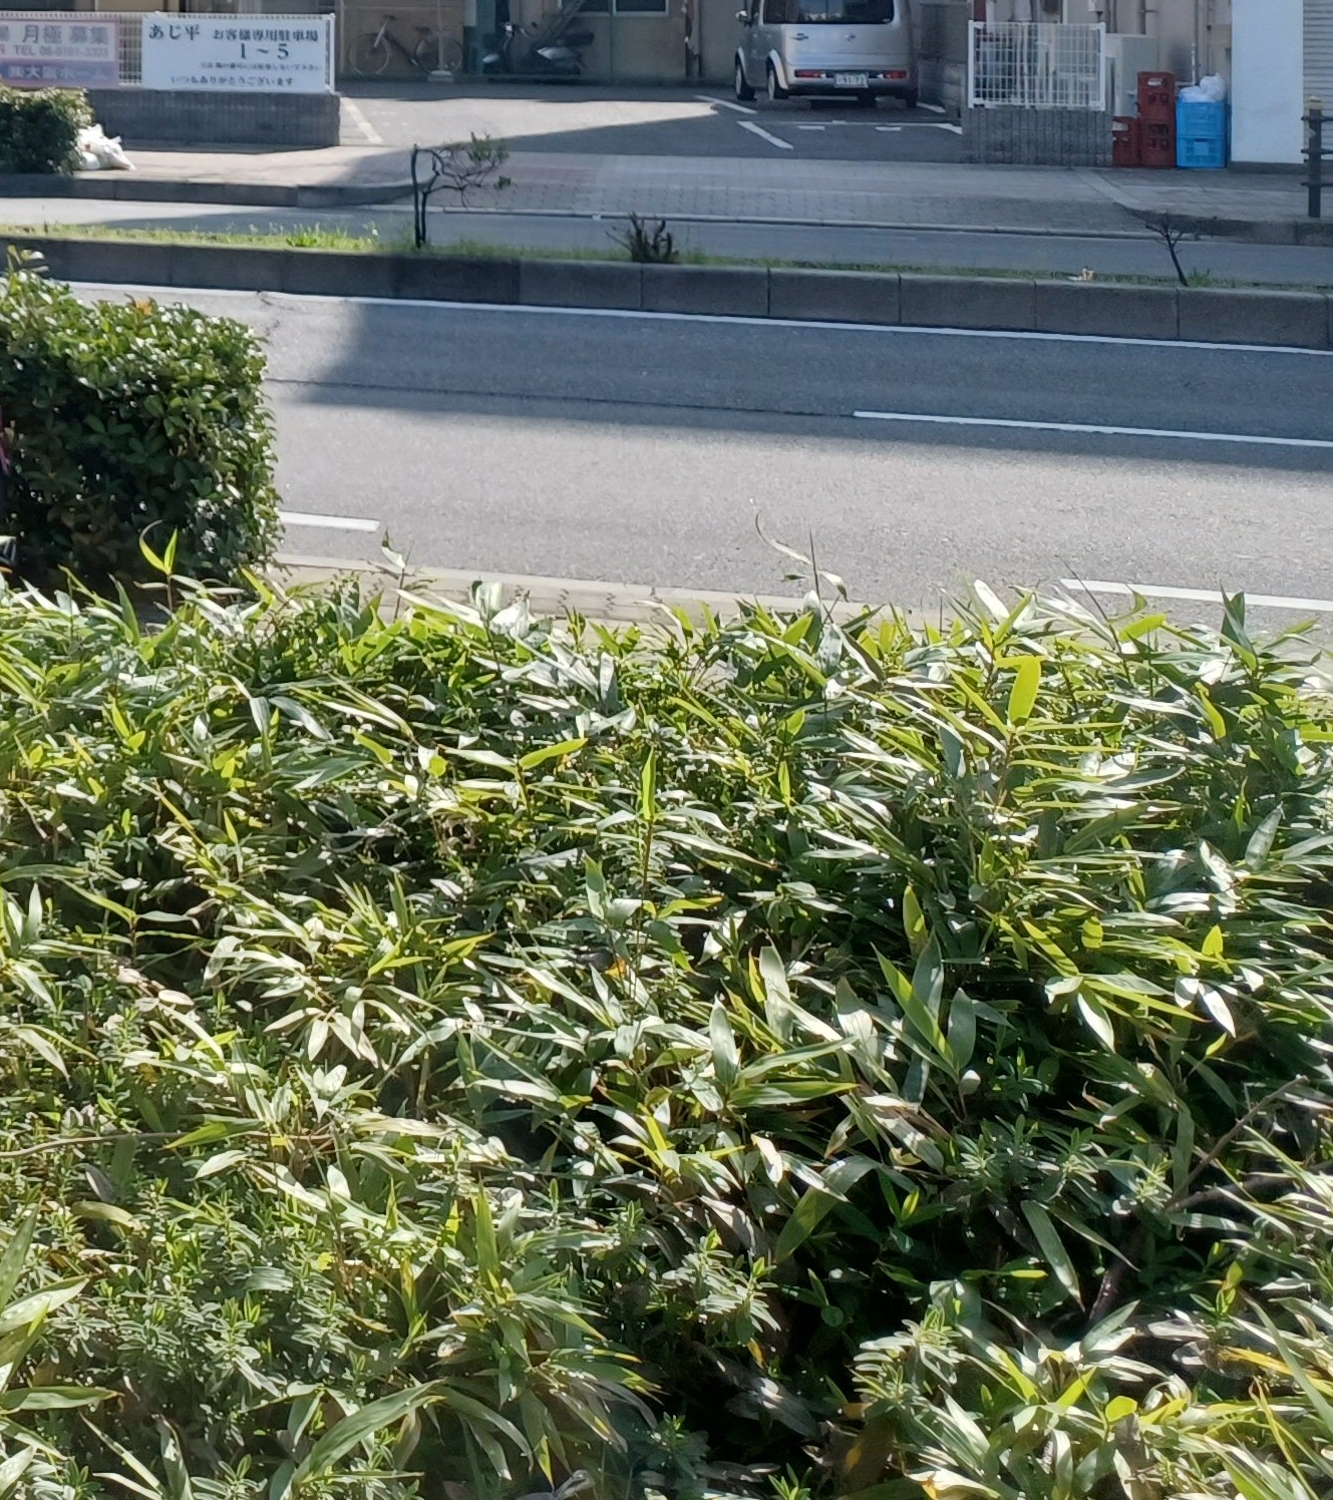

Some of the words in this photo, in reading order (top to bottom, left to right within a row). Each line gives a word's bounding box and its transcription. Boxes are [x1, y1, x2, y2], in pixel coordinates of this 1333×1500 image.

[22, 24, 62, 43] 月極
[149, 24, 200, 40] あじ平
[213, 29, 319, 42] お客様専用駐車場
